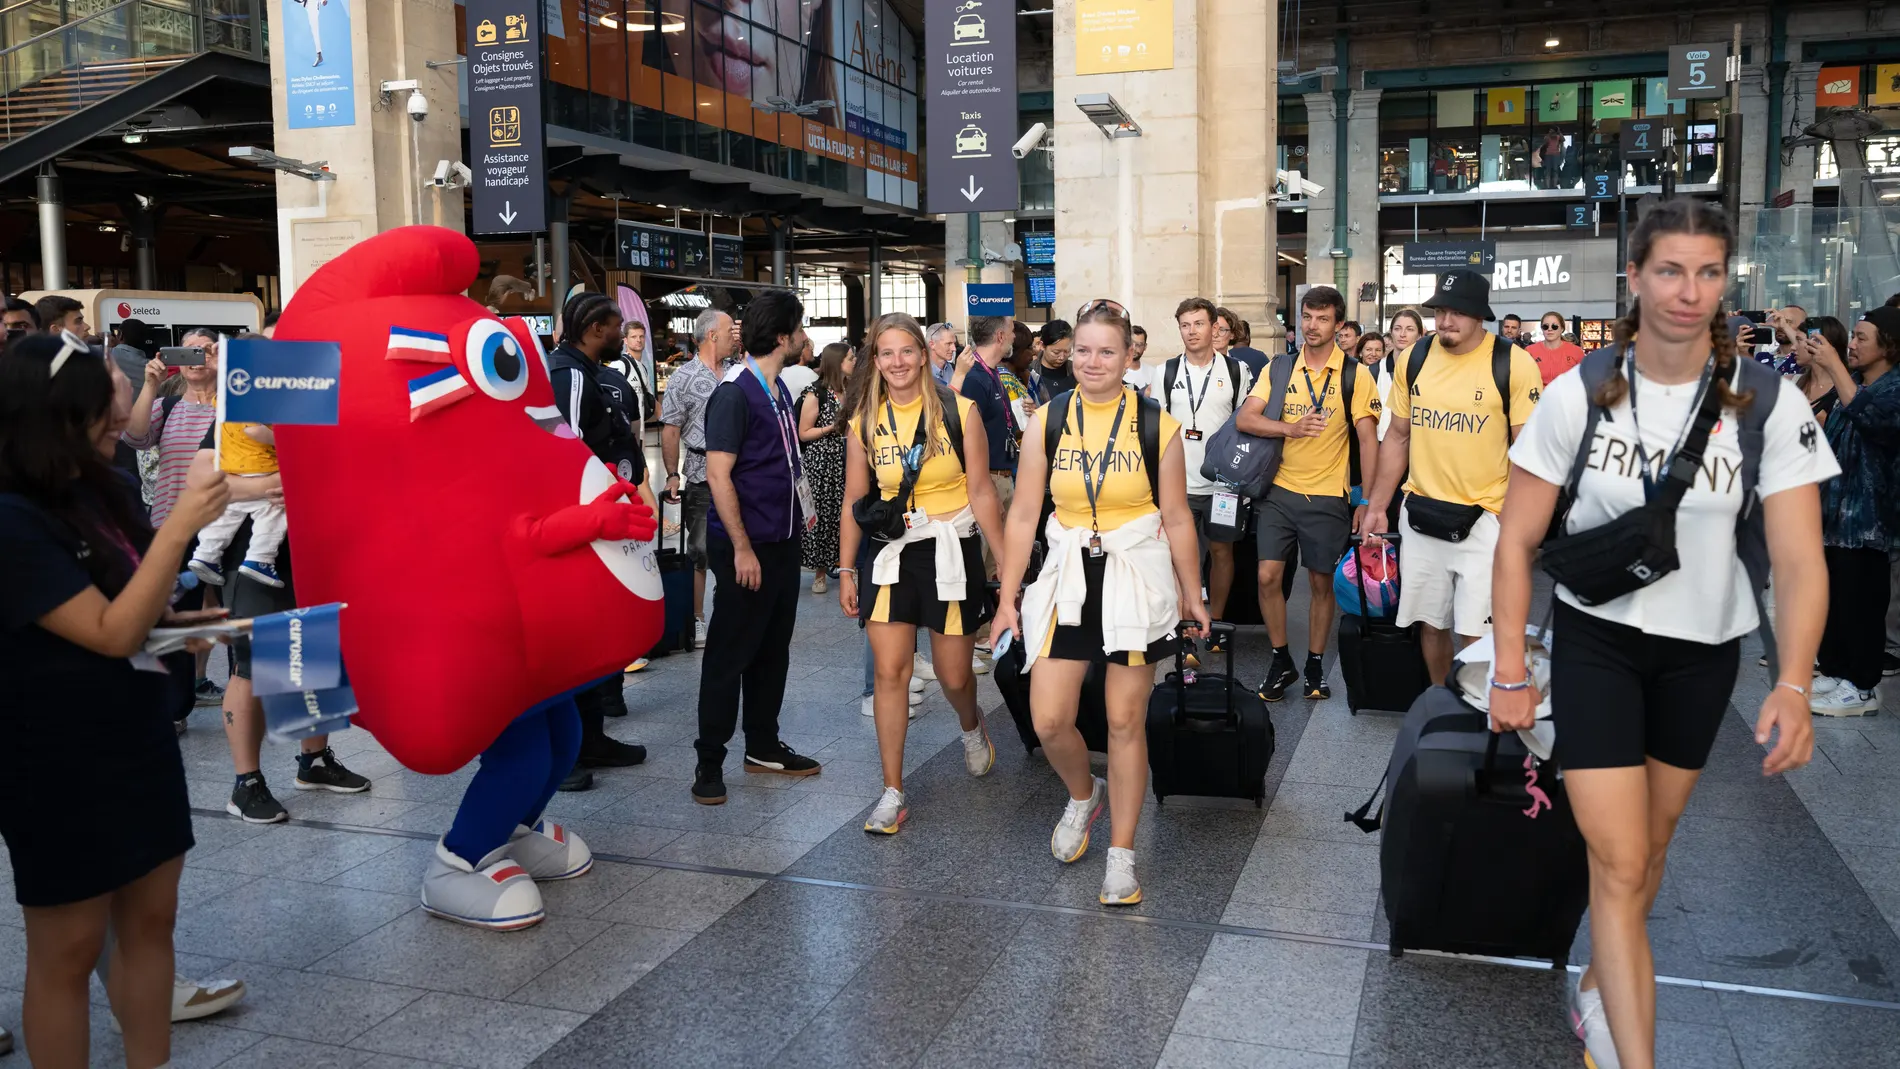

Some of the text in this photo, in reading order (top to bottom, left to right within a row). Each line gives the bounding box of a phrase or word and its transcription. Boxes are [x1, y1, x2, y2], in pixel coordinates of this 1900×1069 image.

[482, 50, 524, 62] Consignes
[850, 20, 906, 85] Avène
[946, 52, 994, 64] Location
[1689, 52, 1707, 60] Voie
[473, 60, 534, 76] Objets trouvés
[948, 66, 992, 76] voitures
[1689, 62, 1706, 86] 5
[960, 111, 981, 120] Taxis
[808, 133, 831, 152] ULTRA
[832, 141, 855, 160] FLUIDE
[1635, 132, 1648, 150] 4
[484, 153, 529, 164] Assistance
[870, 152, 888, 169] ULTRA
[486, 166, 527, 176] voyageur
[485, 175, 529, 187] handicapé
[1596, 182, 1607, 196] 3
[1576, 213, 1584, 224] 2
[1492, 255, 1562, 291] RELAY
[1445, 278, 1454, 286] D
[132, 307, 160, 315] selecta
[254, 376, 336, 390] eurostar
[1328, 387, 1335, 395] D
[1475, 390, 1483, 401] D
[1284, 403, 1337, 418] GERMNY
[1412, 406, 1490, 434] ERMANY
[875, 437, 952, 466] GERNY
[1233, 455, 1240, 464] D
[1586, 434, 1742, 494] ERMNY
[1633, 565, 1652, 580] D
[289, 618, 302, 687] eurostar
